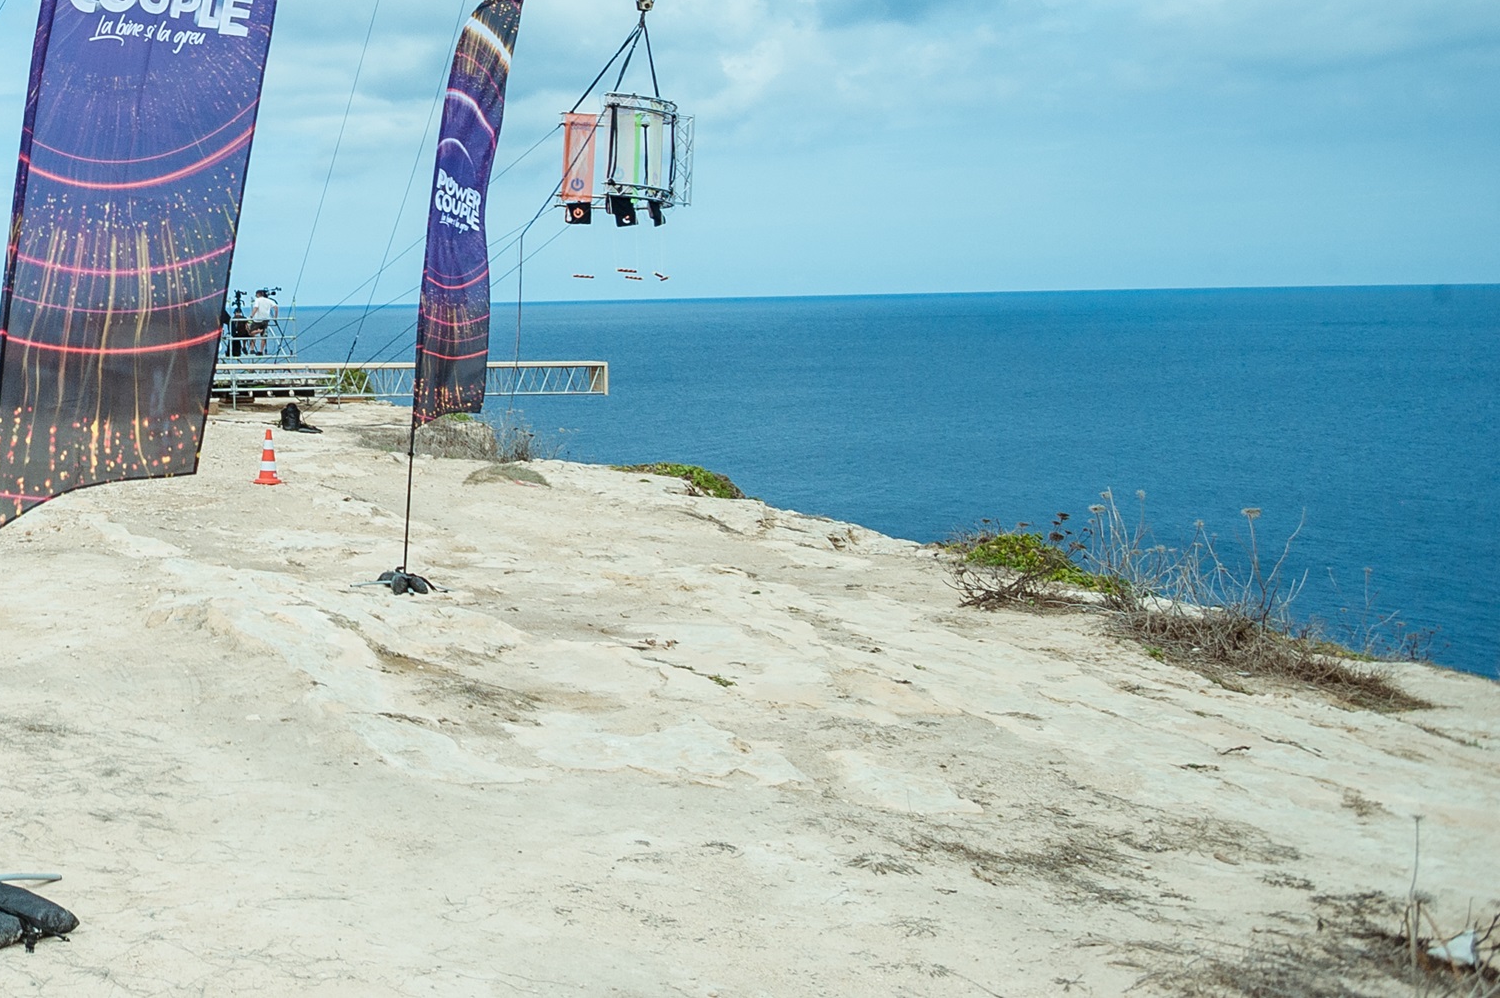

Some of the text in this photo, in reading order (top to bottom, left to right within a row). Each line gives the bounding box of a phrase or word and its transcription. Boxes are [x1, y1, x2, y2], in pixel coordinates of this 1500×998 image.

[115, 14, 144, 37] bine
[156, 20, 172, 42] la
[172, 30, 206, 54] greu
[435, 190, 480, 231] COUPLE
[436, 168, 481, 212] POWER
